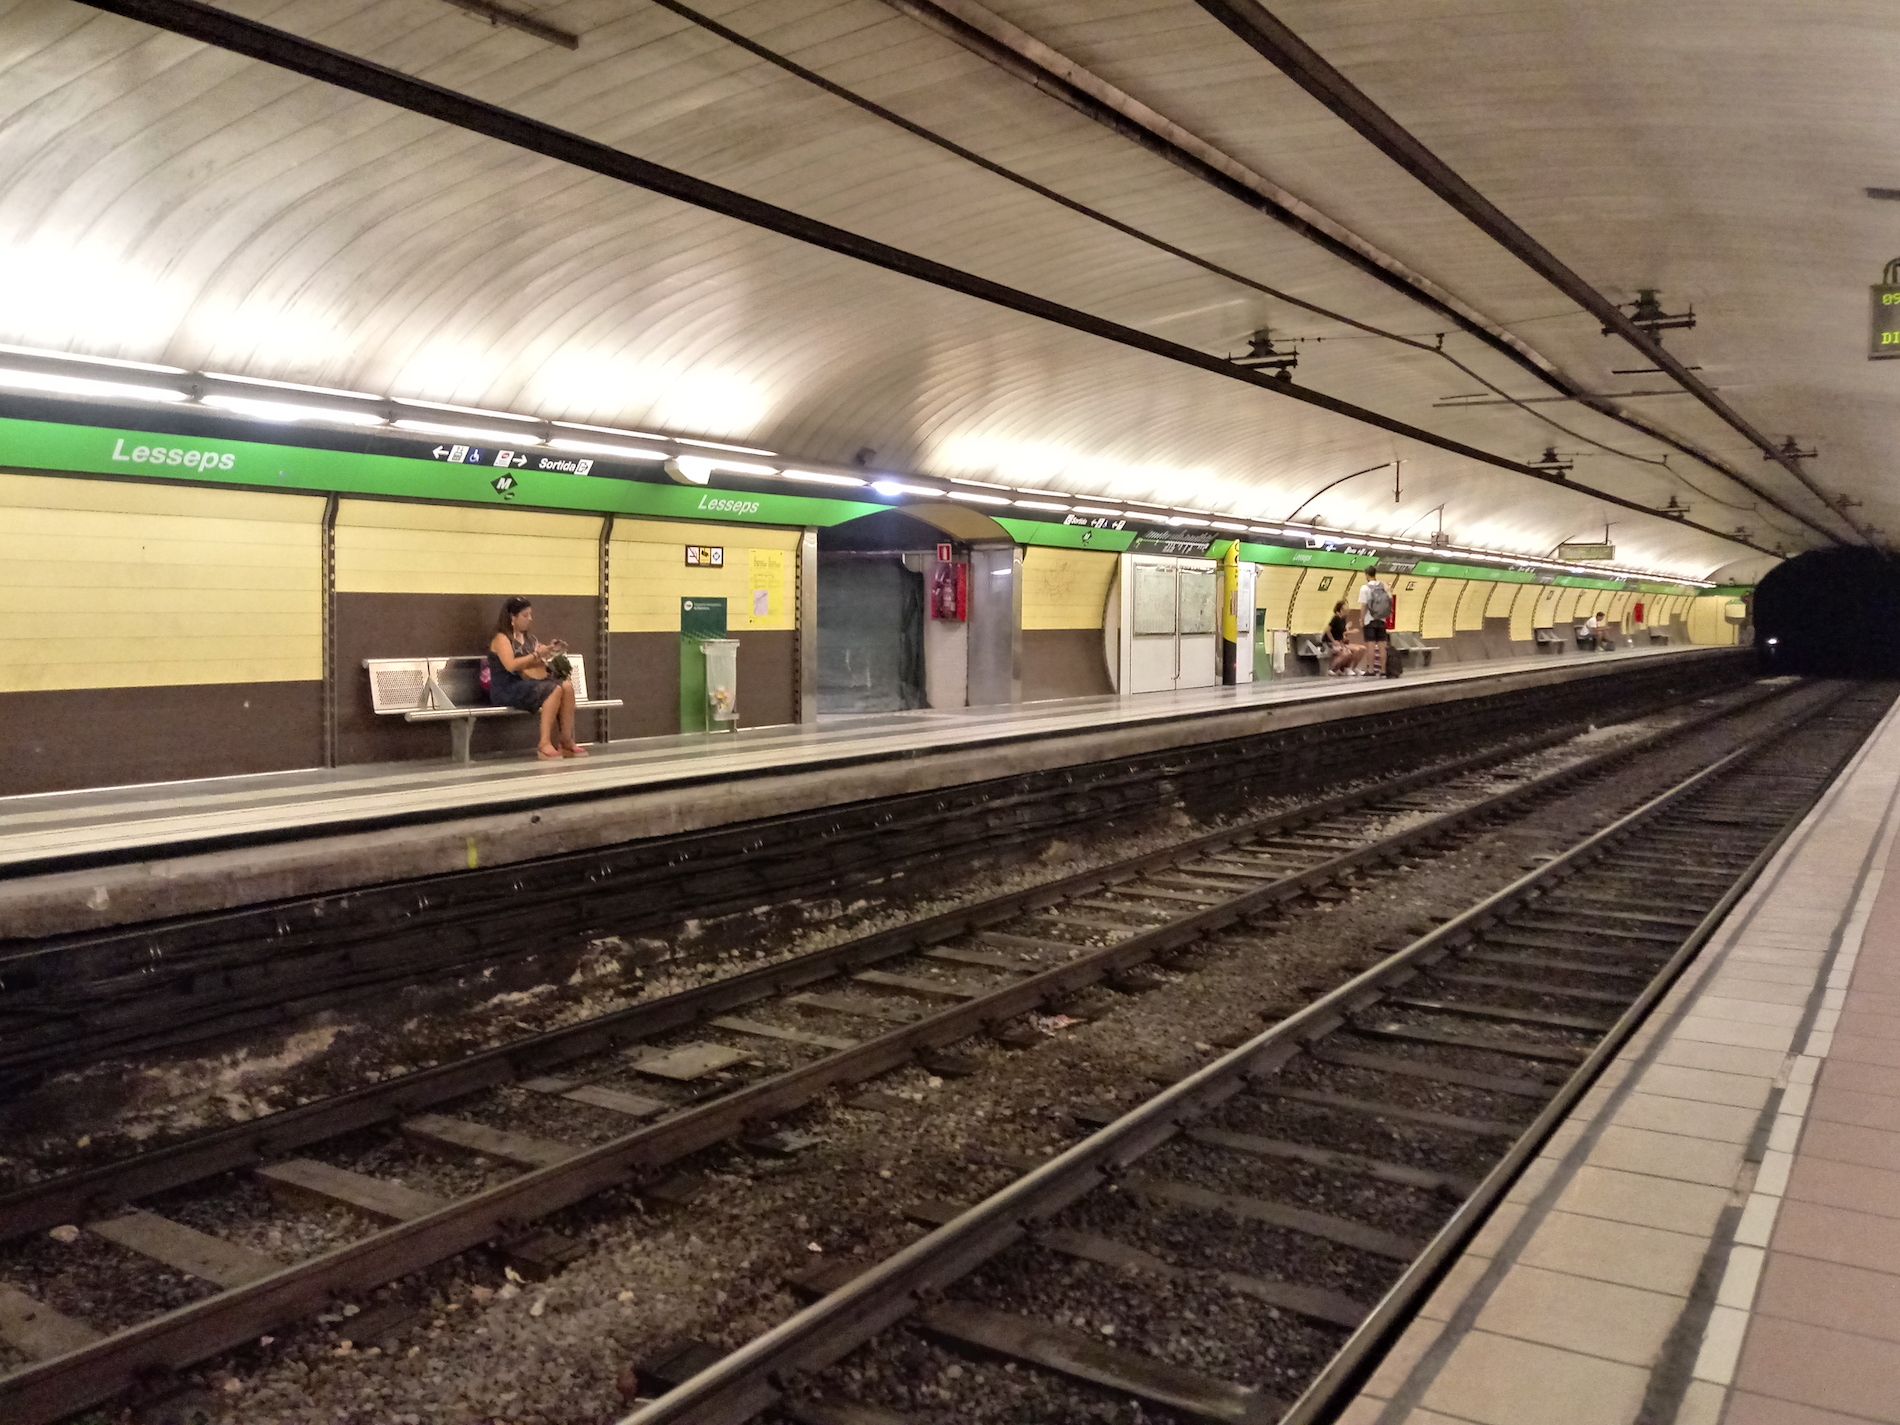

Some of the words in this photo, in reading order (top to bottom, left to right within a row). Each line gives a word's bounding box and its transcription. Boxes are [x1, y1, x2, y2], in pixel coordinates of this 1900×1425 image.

[1881, 331, 1900, 345] DI
[112, 438, 236, 473] Lesseps
[538, 457, 576, 473] Sortida
[496, 477, 512, 490] M
[698, 494, 760, 516] Lesseps
